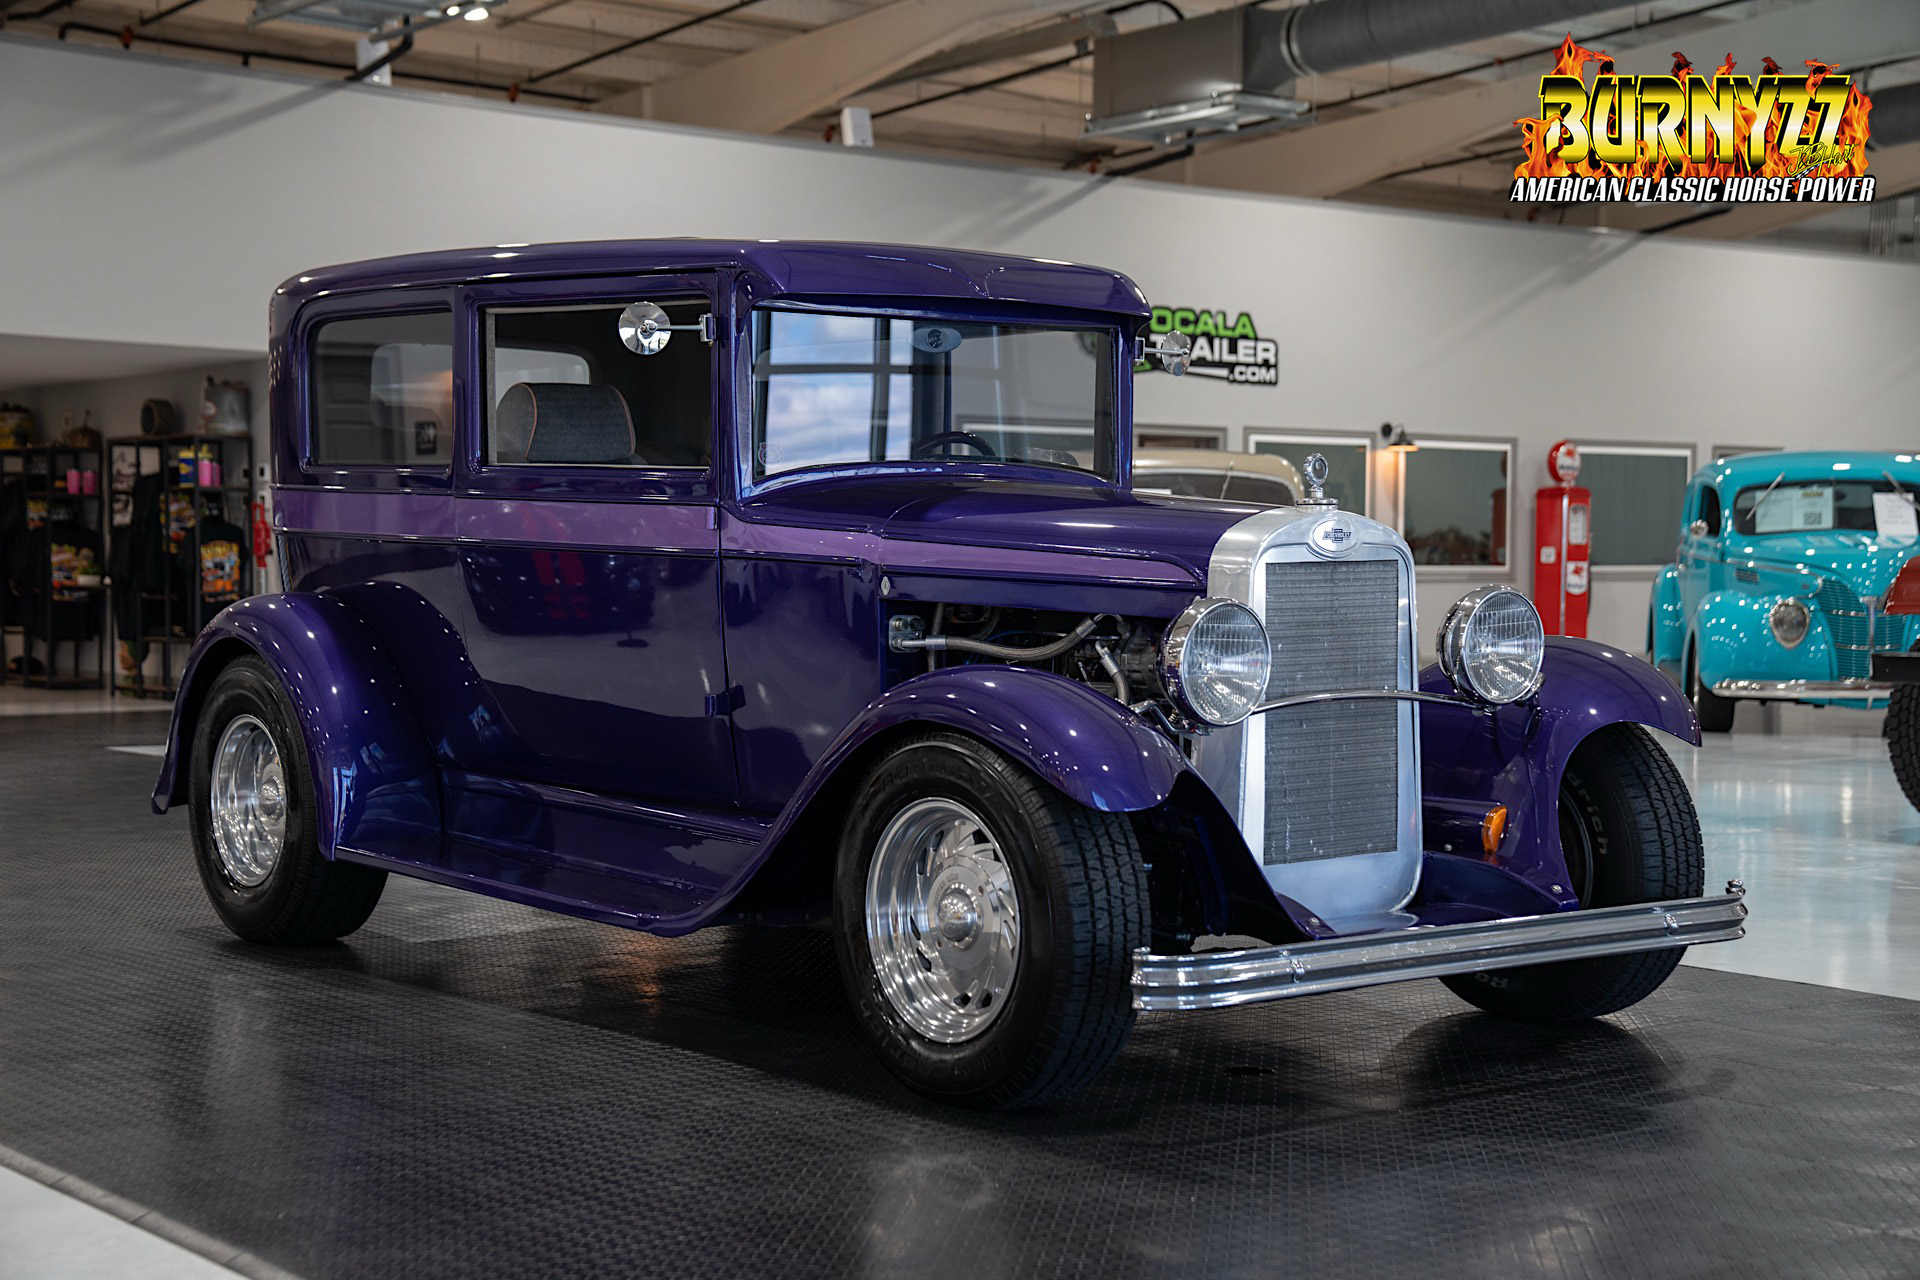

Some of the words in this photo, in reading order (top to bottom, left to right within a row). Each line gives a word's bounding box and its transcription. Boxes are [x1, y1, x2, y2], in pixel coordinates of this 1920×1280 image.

[1150, 307, 1257, 338] OCALA
[1149, 334, 1276, 365] TAILER
[1228, 366, 1276, 384] .COM
